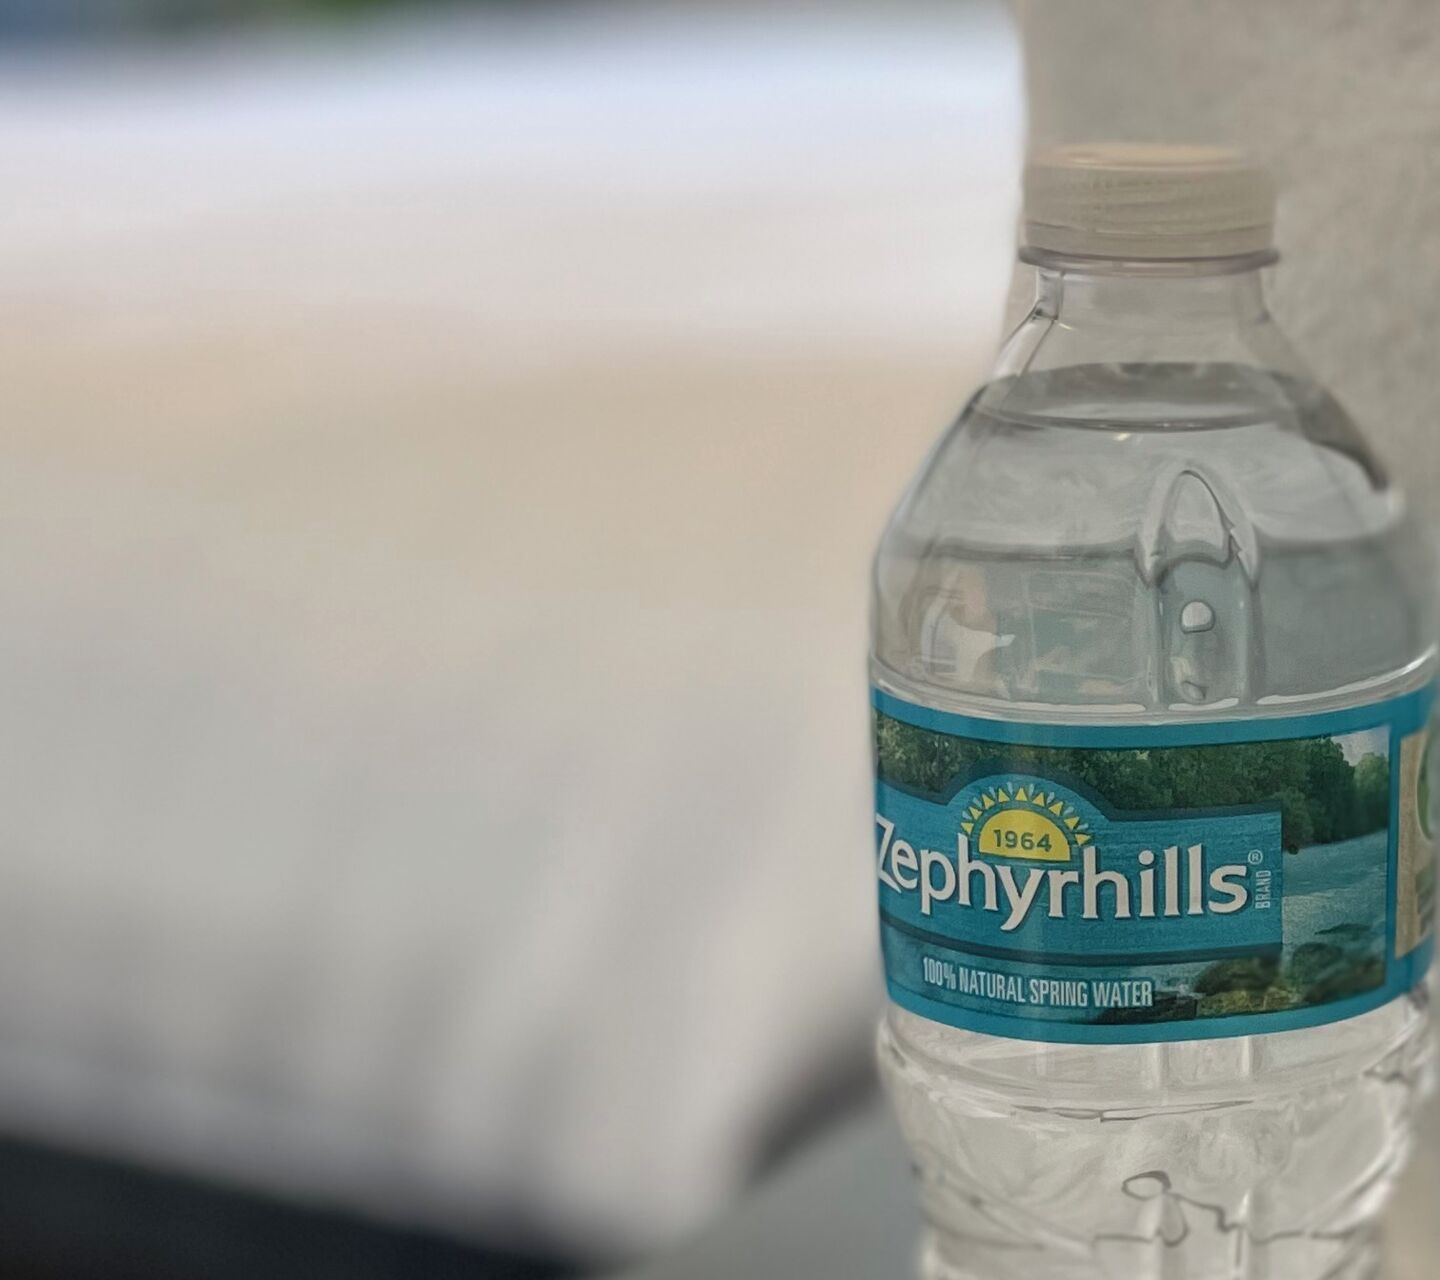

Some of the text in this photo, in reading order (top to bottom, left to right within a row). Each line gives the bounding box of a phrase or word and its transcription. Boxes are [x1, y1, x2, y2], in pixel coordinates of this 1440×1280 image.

[993, 828, 1053, 852] 1964
[1255, 870, 1272, 909] BRAND
[923, 957, 1153, 1007] 100% NATURAL SPRING WATER
